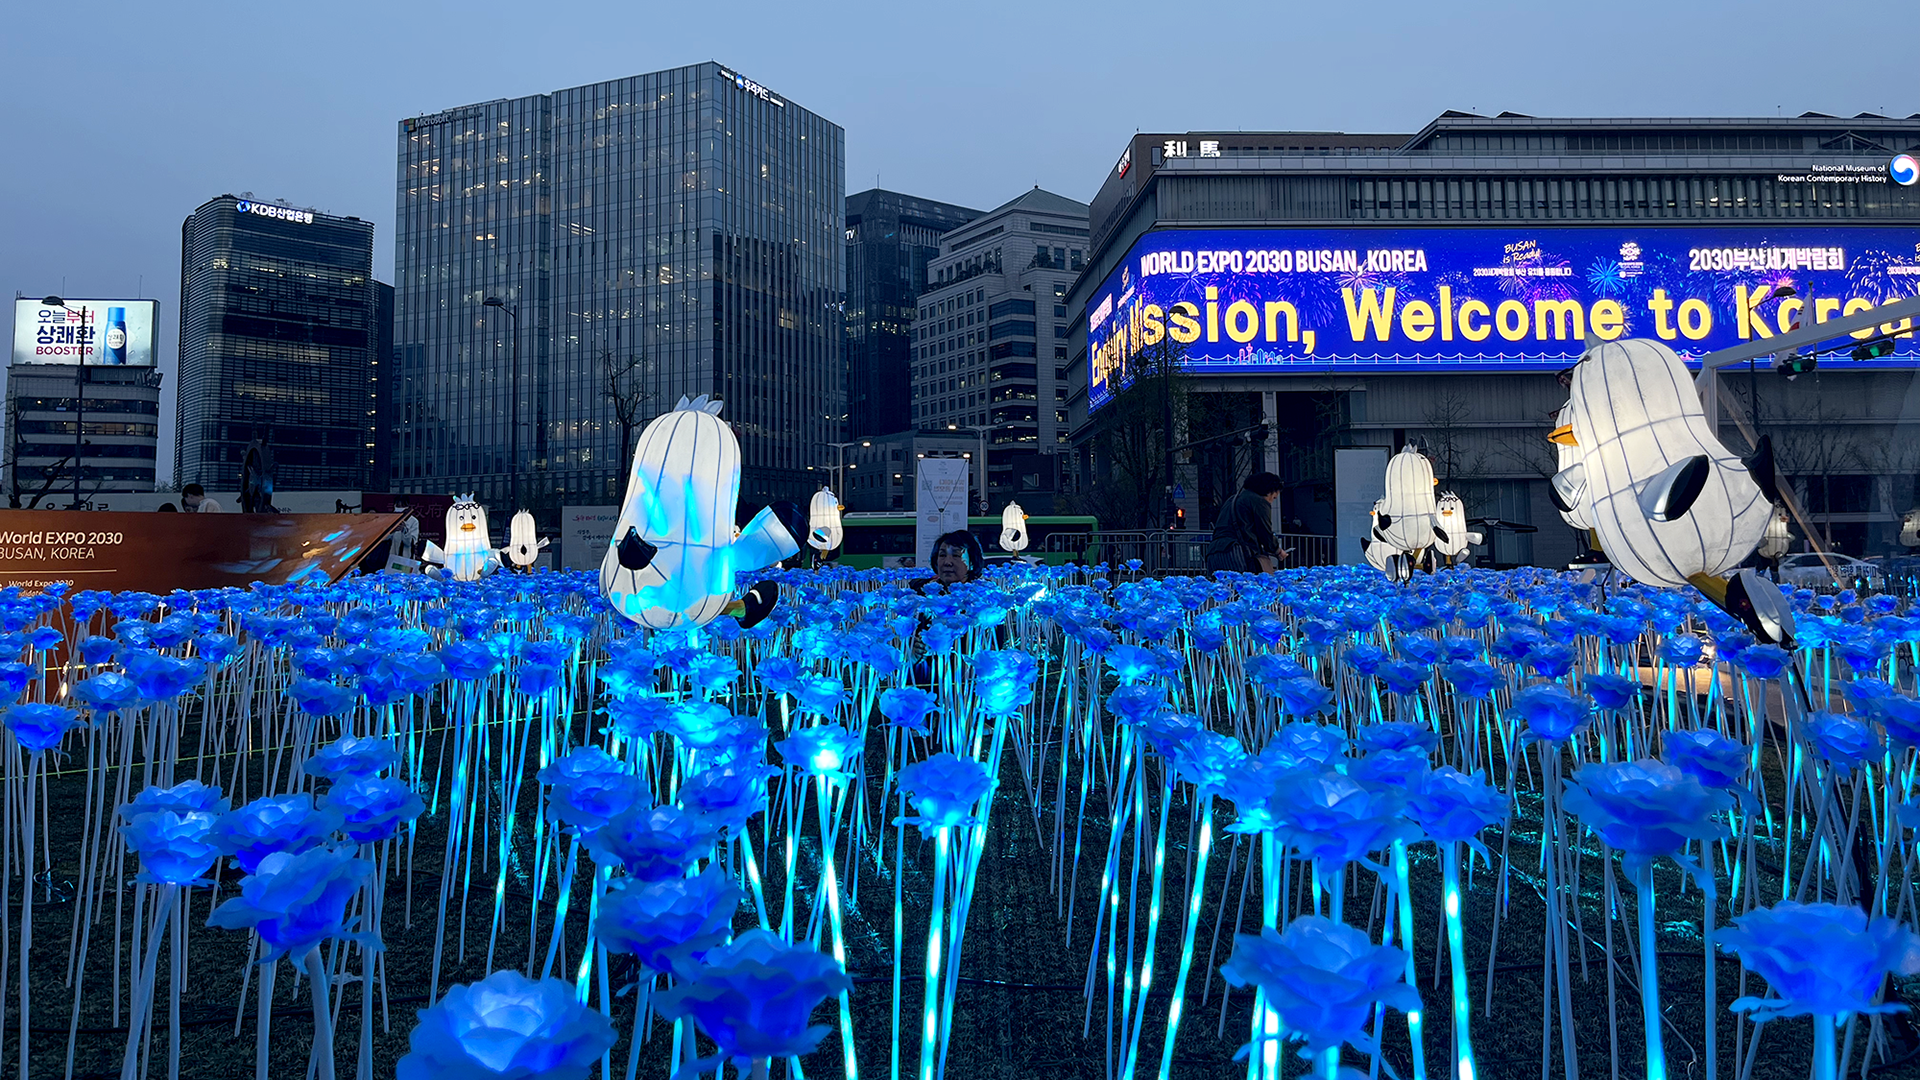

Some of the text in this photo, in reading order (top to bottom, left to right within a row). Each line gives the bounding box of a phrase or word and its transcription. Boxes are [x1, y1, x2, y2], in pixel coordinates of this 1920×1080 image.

[744, 79, 769, 101] 우리카드
[1812, 164, 1844, 172] National
[1846, 164, 1876, 172] Museum
[1778, 174, 1887, 184] Korean Contemporary History
[250, 203, 314, 224] KDB산업은행
[1504, 239, 1537, 253] BUSAN
[1141, 249, 1427, 277] WORLD EXPO 2030 BUSAN, KOREA
[1689, 248, 1844, 271] 2030부산세계박람회
[37, 309, 95, 324] 오늘부터
[1342, 286, 1625, 342] Welcome
[1648, 288, 1712, 341] to
[37, 326, 96, 345] 상쾌환
[0, 531, 124, 545] World EXPO 2030
[0, 547, 95, 561] BUSAN, KOREA
[34, 580, 54, 588] Expo
